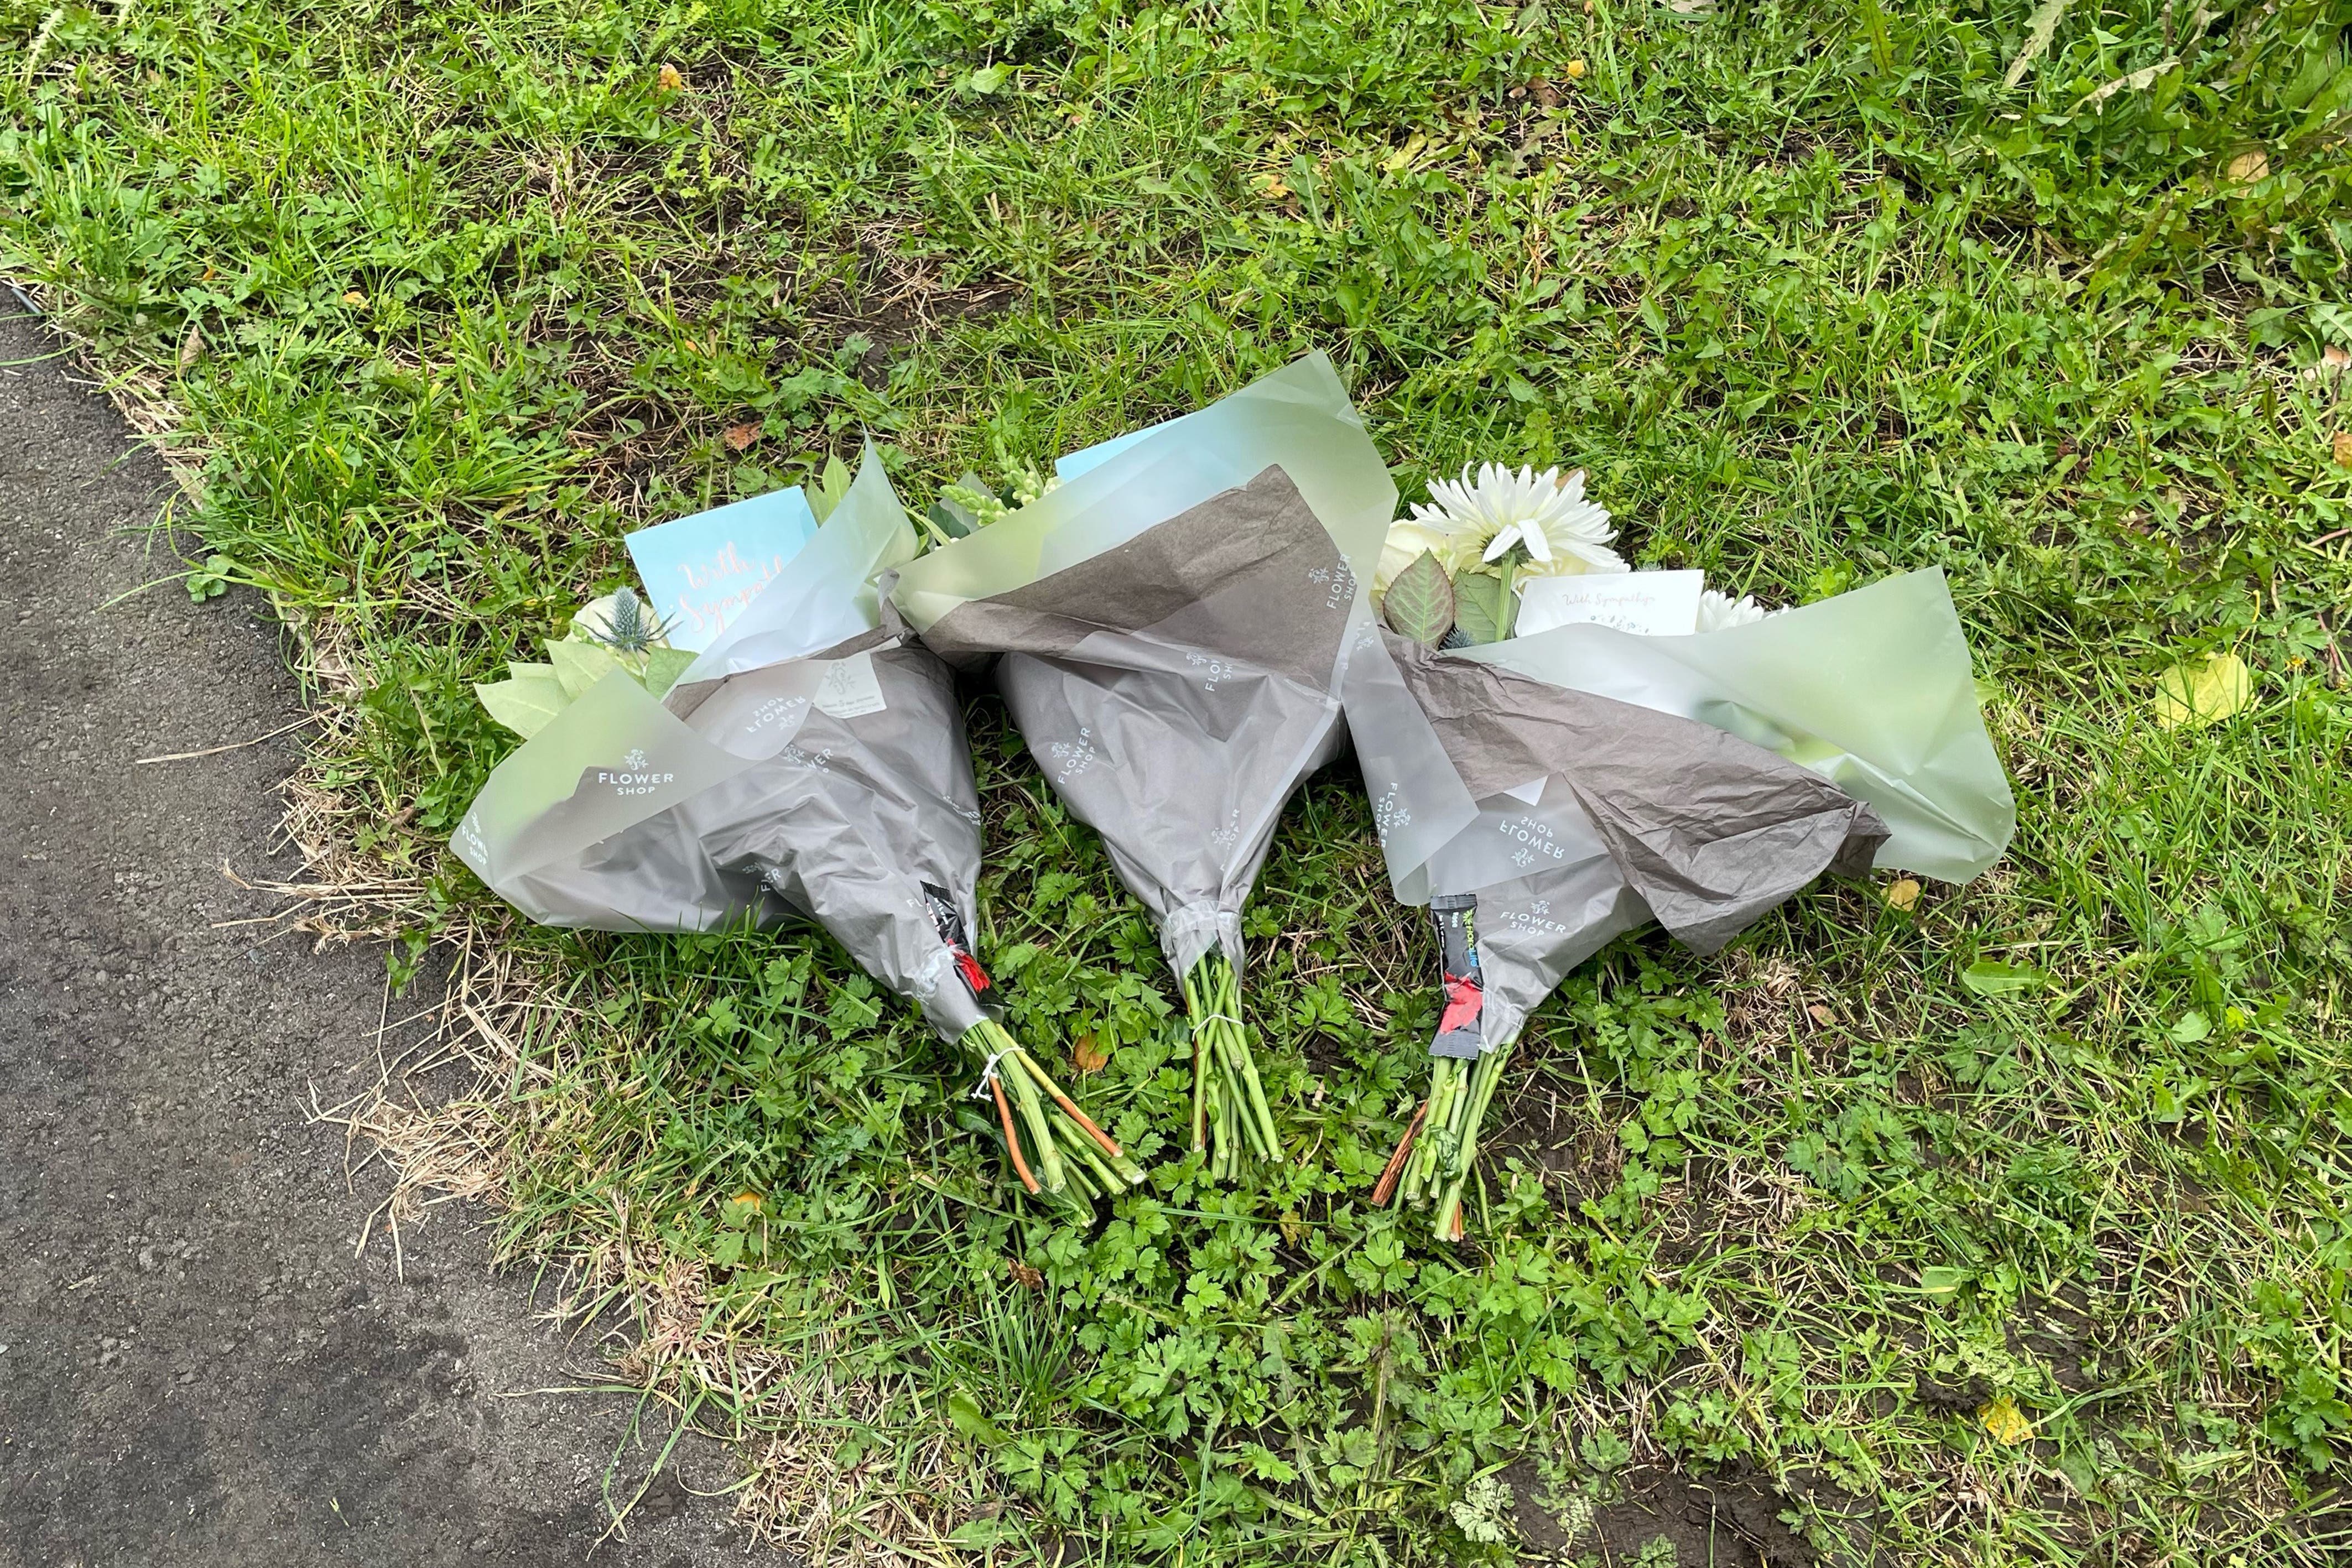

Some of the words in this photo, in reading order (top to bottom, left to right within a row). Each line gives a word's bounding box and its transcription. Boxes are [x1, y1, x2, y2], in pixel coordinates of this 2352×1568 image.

[677, 541, 756, 590] With
[1326, 554, 1351, 609] FLOWER
[1344, 571, 1357, 601] SHOP
[1562, 593, 1591, 606] With
[1595, 592, 1656, 608] Sympathy
[1058, 727, 1091, 784] FLOWER
[1075, 746, 1096, 774] SHOP
[599, 772, 674, 785] FLOWER
[617, 786, 655, 795] SHOP
[1376, 796, 1385, 830] SHOP
[1381, 782, 1398, 848] FLOWER
[1499, 911, 1567, 933] FLOWER
[1510, 921, 1545, 936] SHOP
